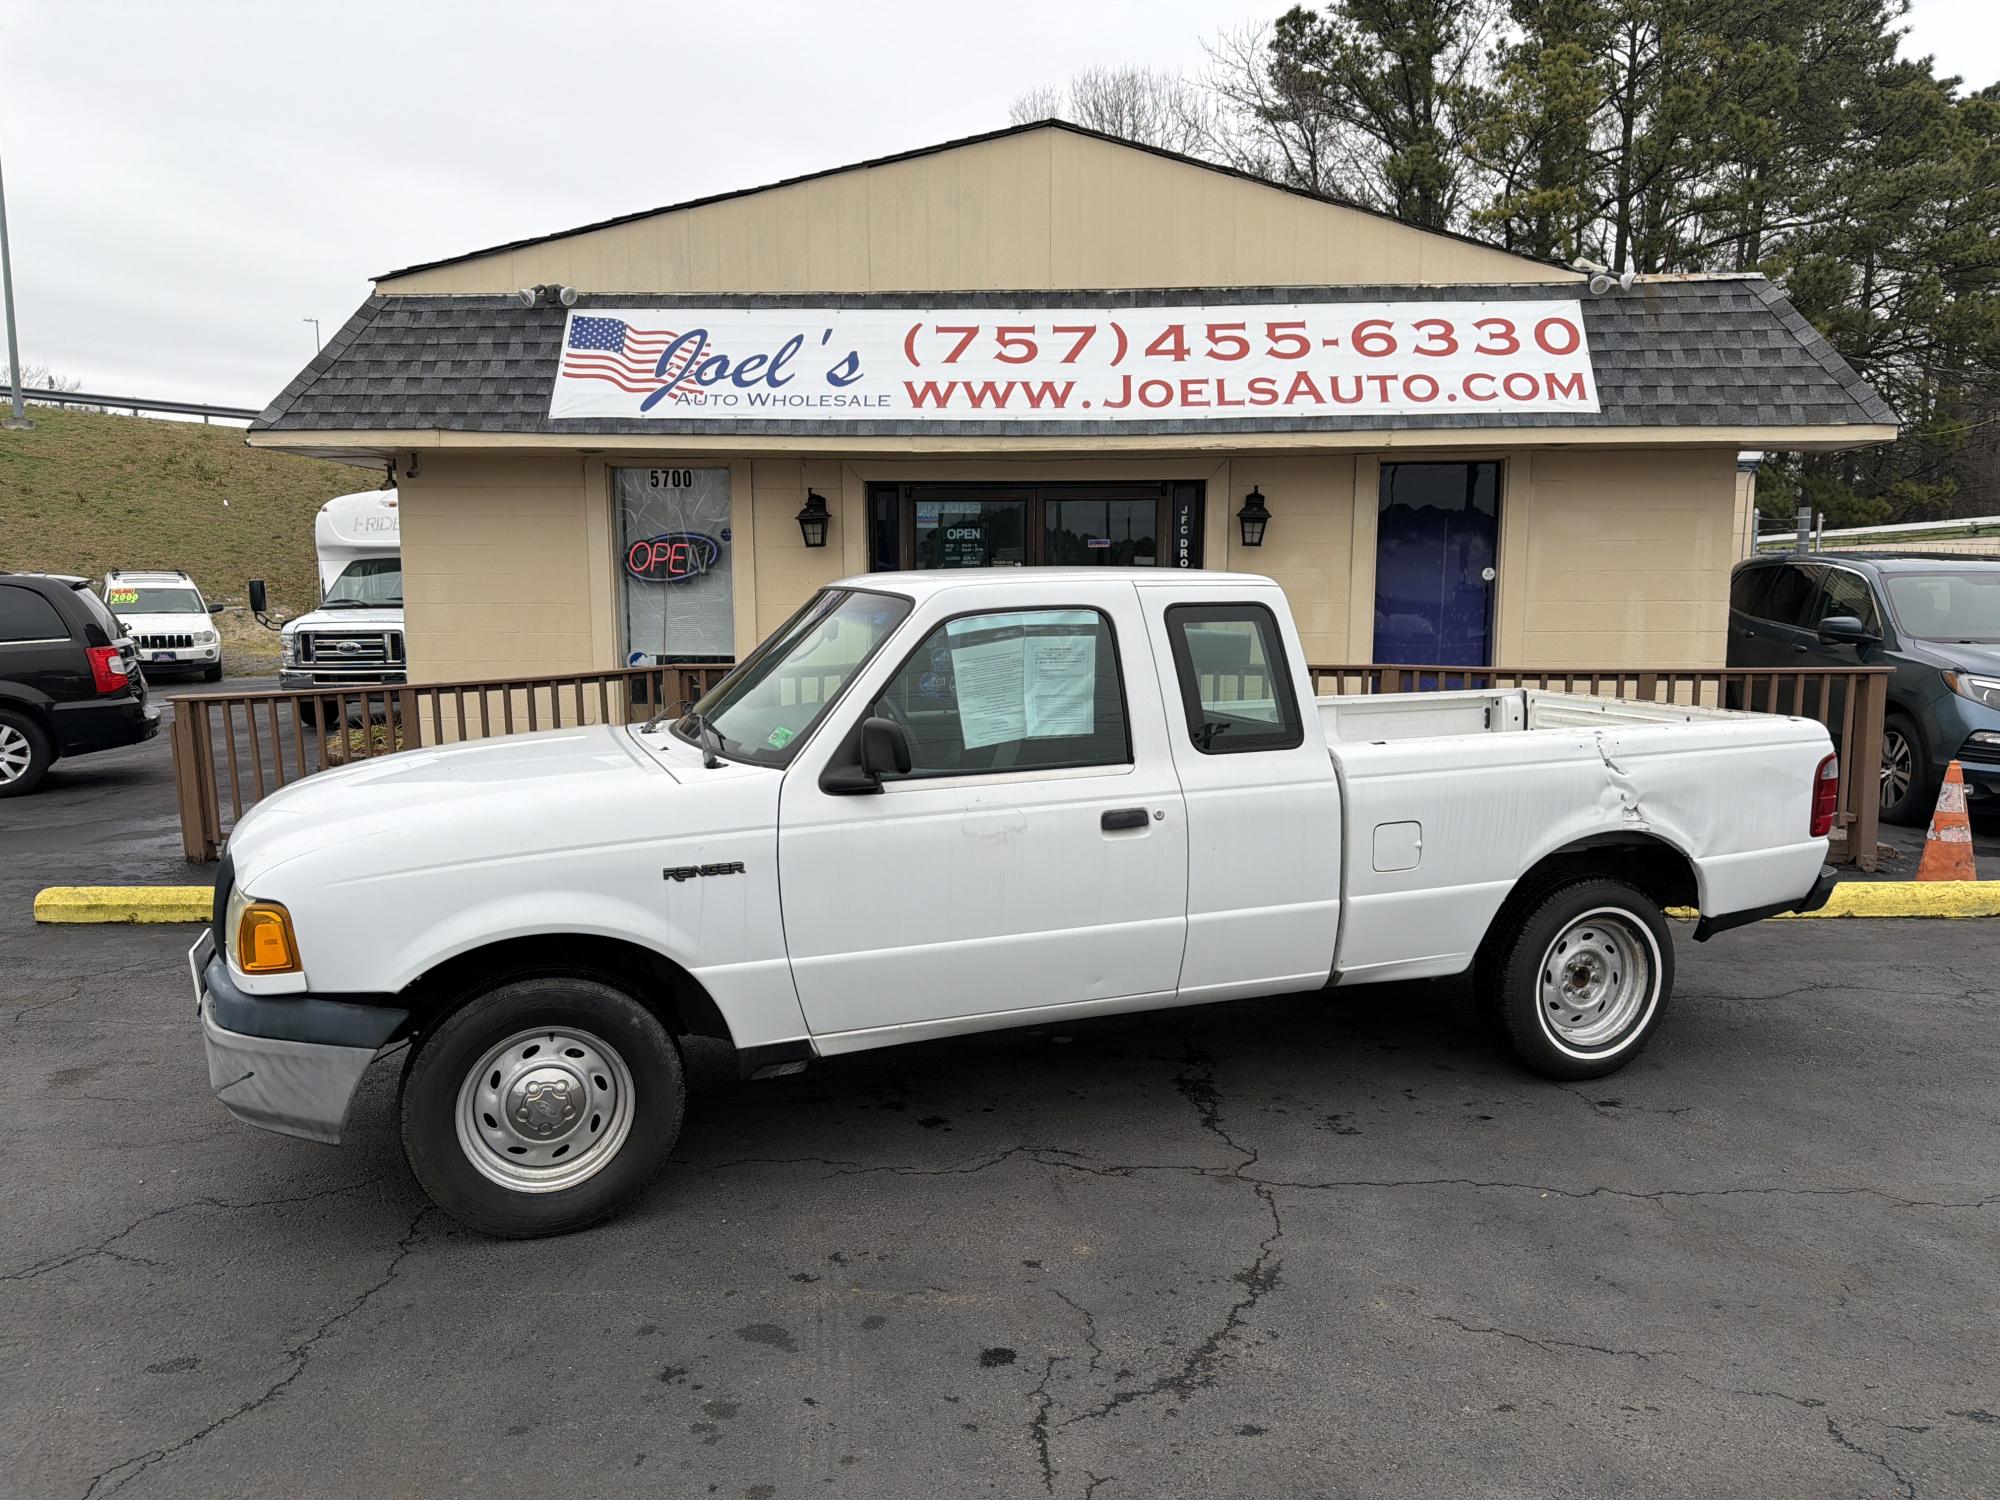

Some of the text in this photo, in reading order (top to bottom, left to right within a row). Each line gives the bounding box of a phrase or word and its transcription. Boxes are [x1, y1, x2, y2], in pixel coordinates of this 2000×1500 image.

[904, 317, 1581, 368] (757)455-6330
[640, 328, 865, 412] Joel's
[650, 469, 693, 488] 5700
[946, 527, 981, 540] OPEN
[629, 541, 710, 574] OPEN
